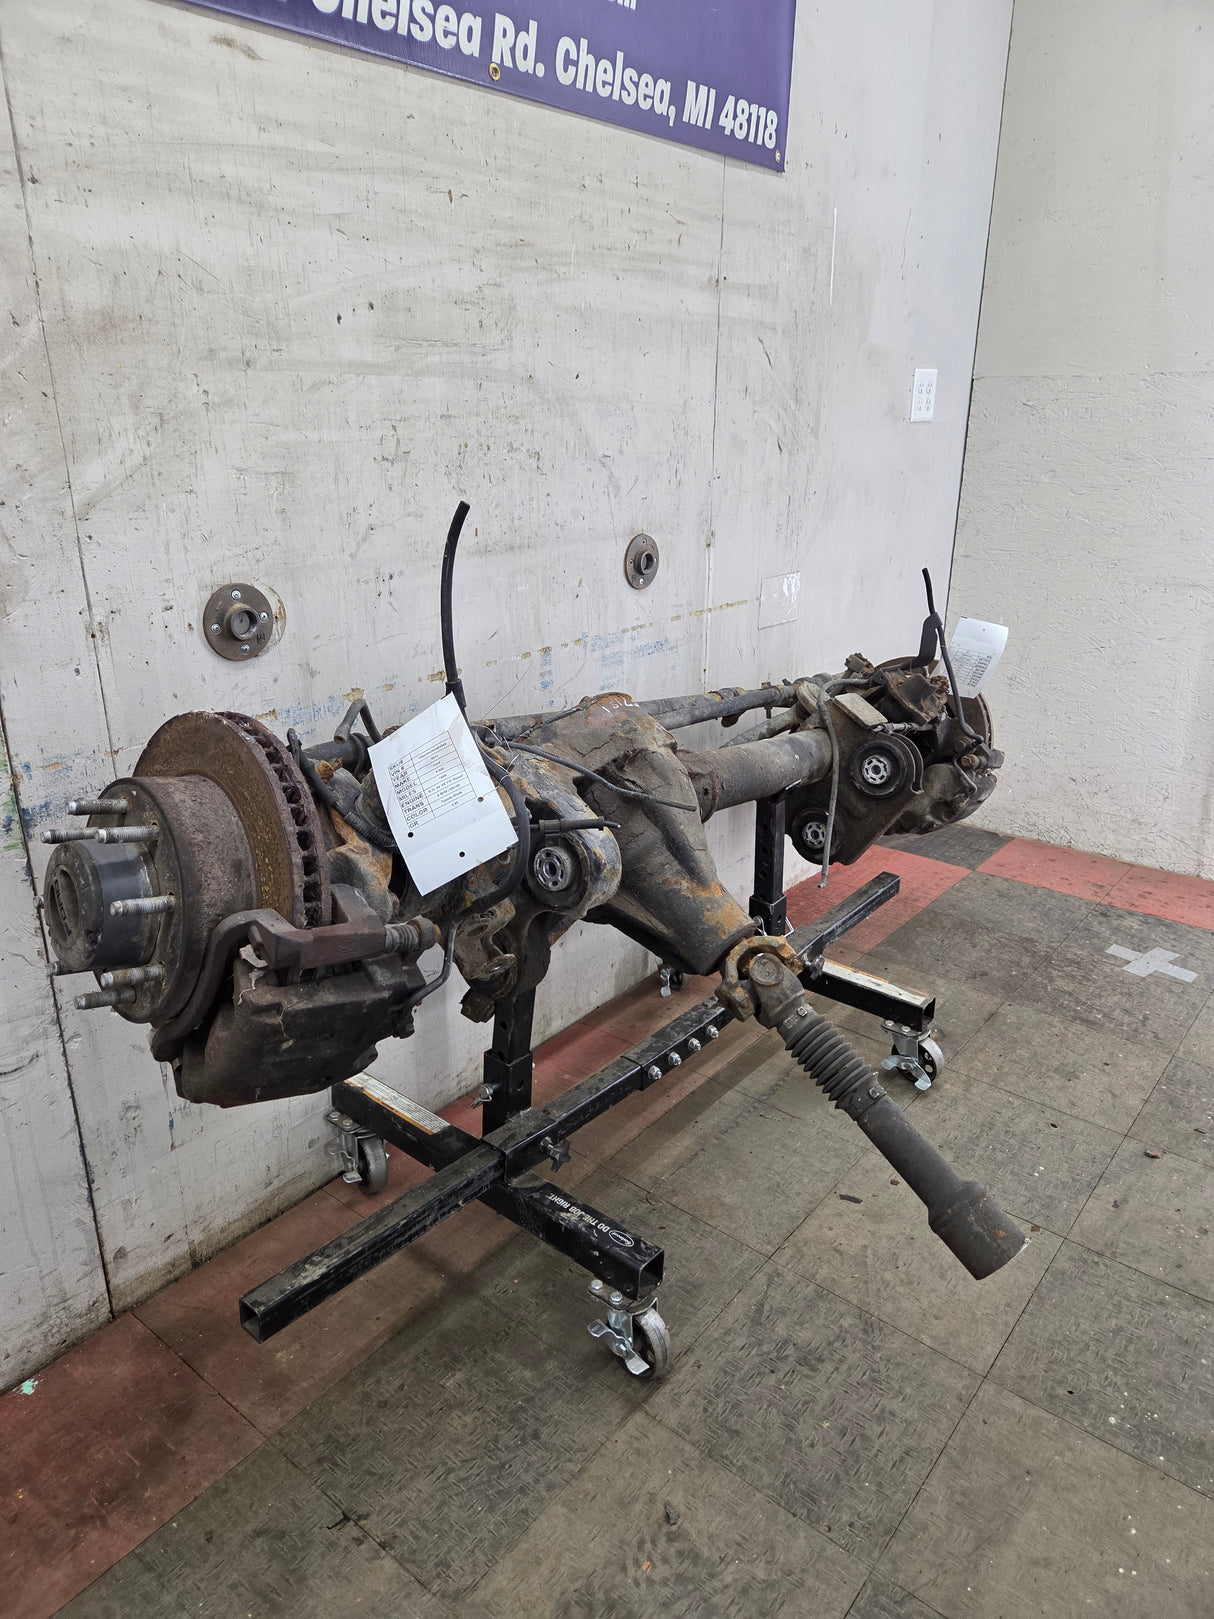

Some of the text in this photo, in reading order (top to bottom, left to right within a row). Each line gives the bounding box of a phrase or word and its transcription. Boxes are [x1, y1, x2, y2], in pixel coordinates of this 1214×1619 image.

[311, 0, 778, 149] elsea Rd. Chelsea, MI 48118
[393, 771, 408, 782] YEAR
[394, 777, 411, 788] MAKE
[396, 782, 417, 795] MODEL
[398, 789, 417, 801] MILES
[401, 793, 424, 808] ENGINE
[403, 801, 425, 815] TRANS
[407, 807, 428, 821] COLOR
[409, 821, 420, 829] GR
[568, 1206, 585, 1217] JOB
[582, 1215, 599, 1226] THE
[597, 1223, 611, 1233] DO
